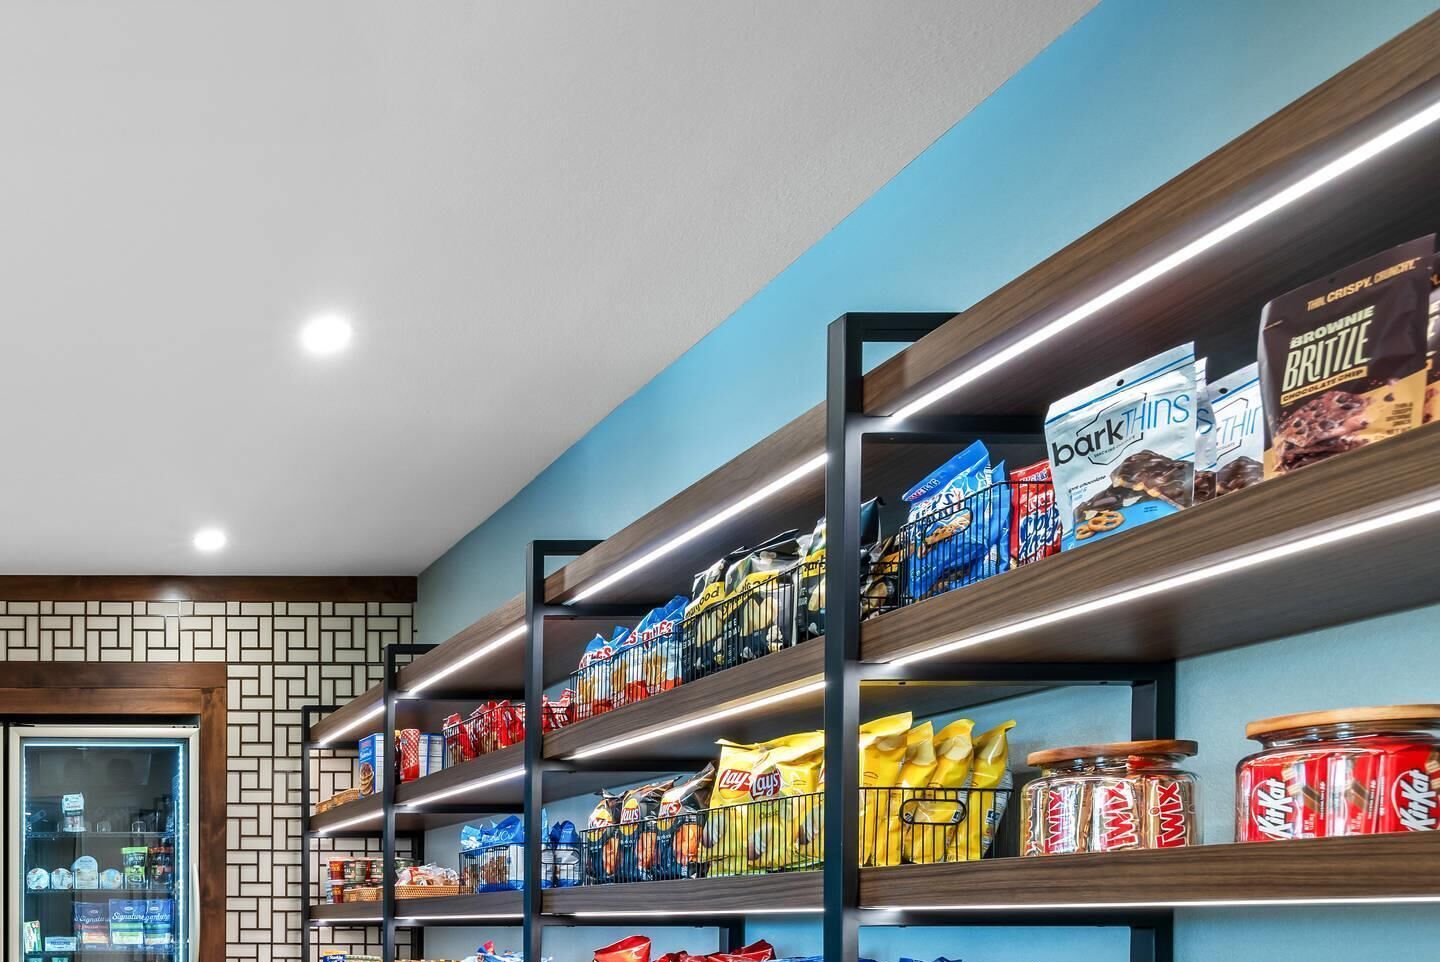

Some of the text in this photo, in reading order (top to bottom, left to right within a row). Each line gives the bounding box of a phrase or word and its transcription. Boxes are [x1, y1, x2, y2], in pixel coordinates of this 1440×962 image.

[1282, 320, 1372, 393] BRITTLE
[1290, 305, 1375, 350] BROWNIE
[1338, 368, 1364, 386] CHIP
[752, 766, 780, 797] Lay's
[1257, 777, 1294, 839] KitKat
[1399, 768, 1437, 831] KitKat
[1148, 782, 1188, 849] TWIX
